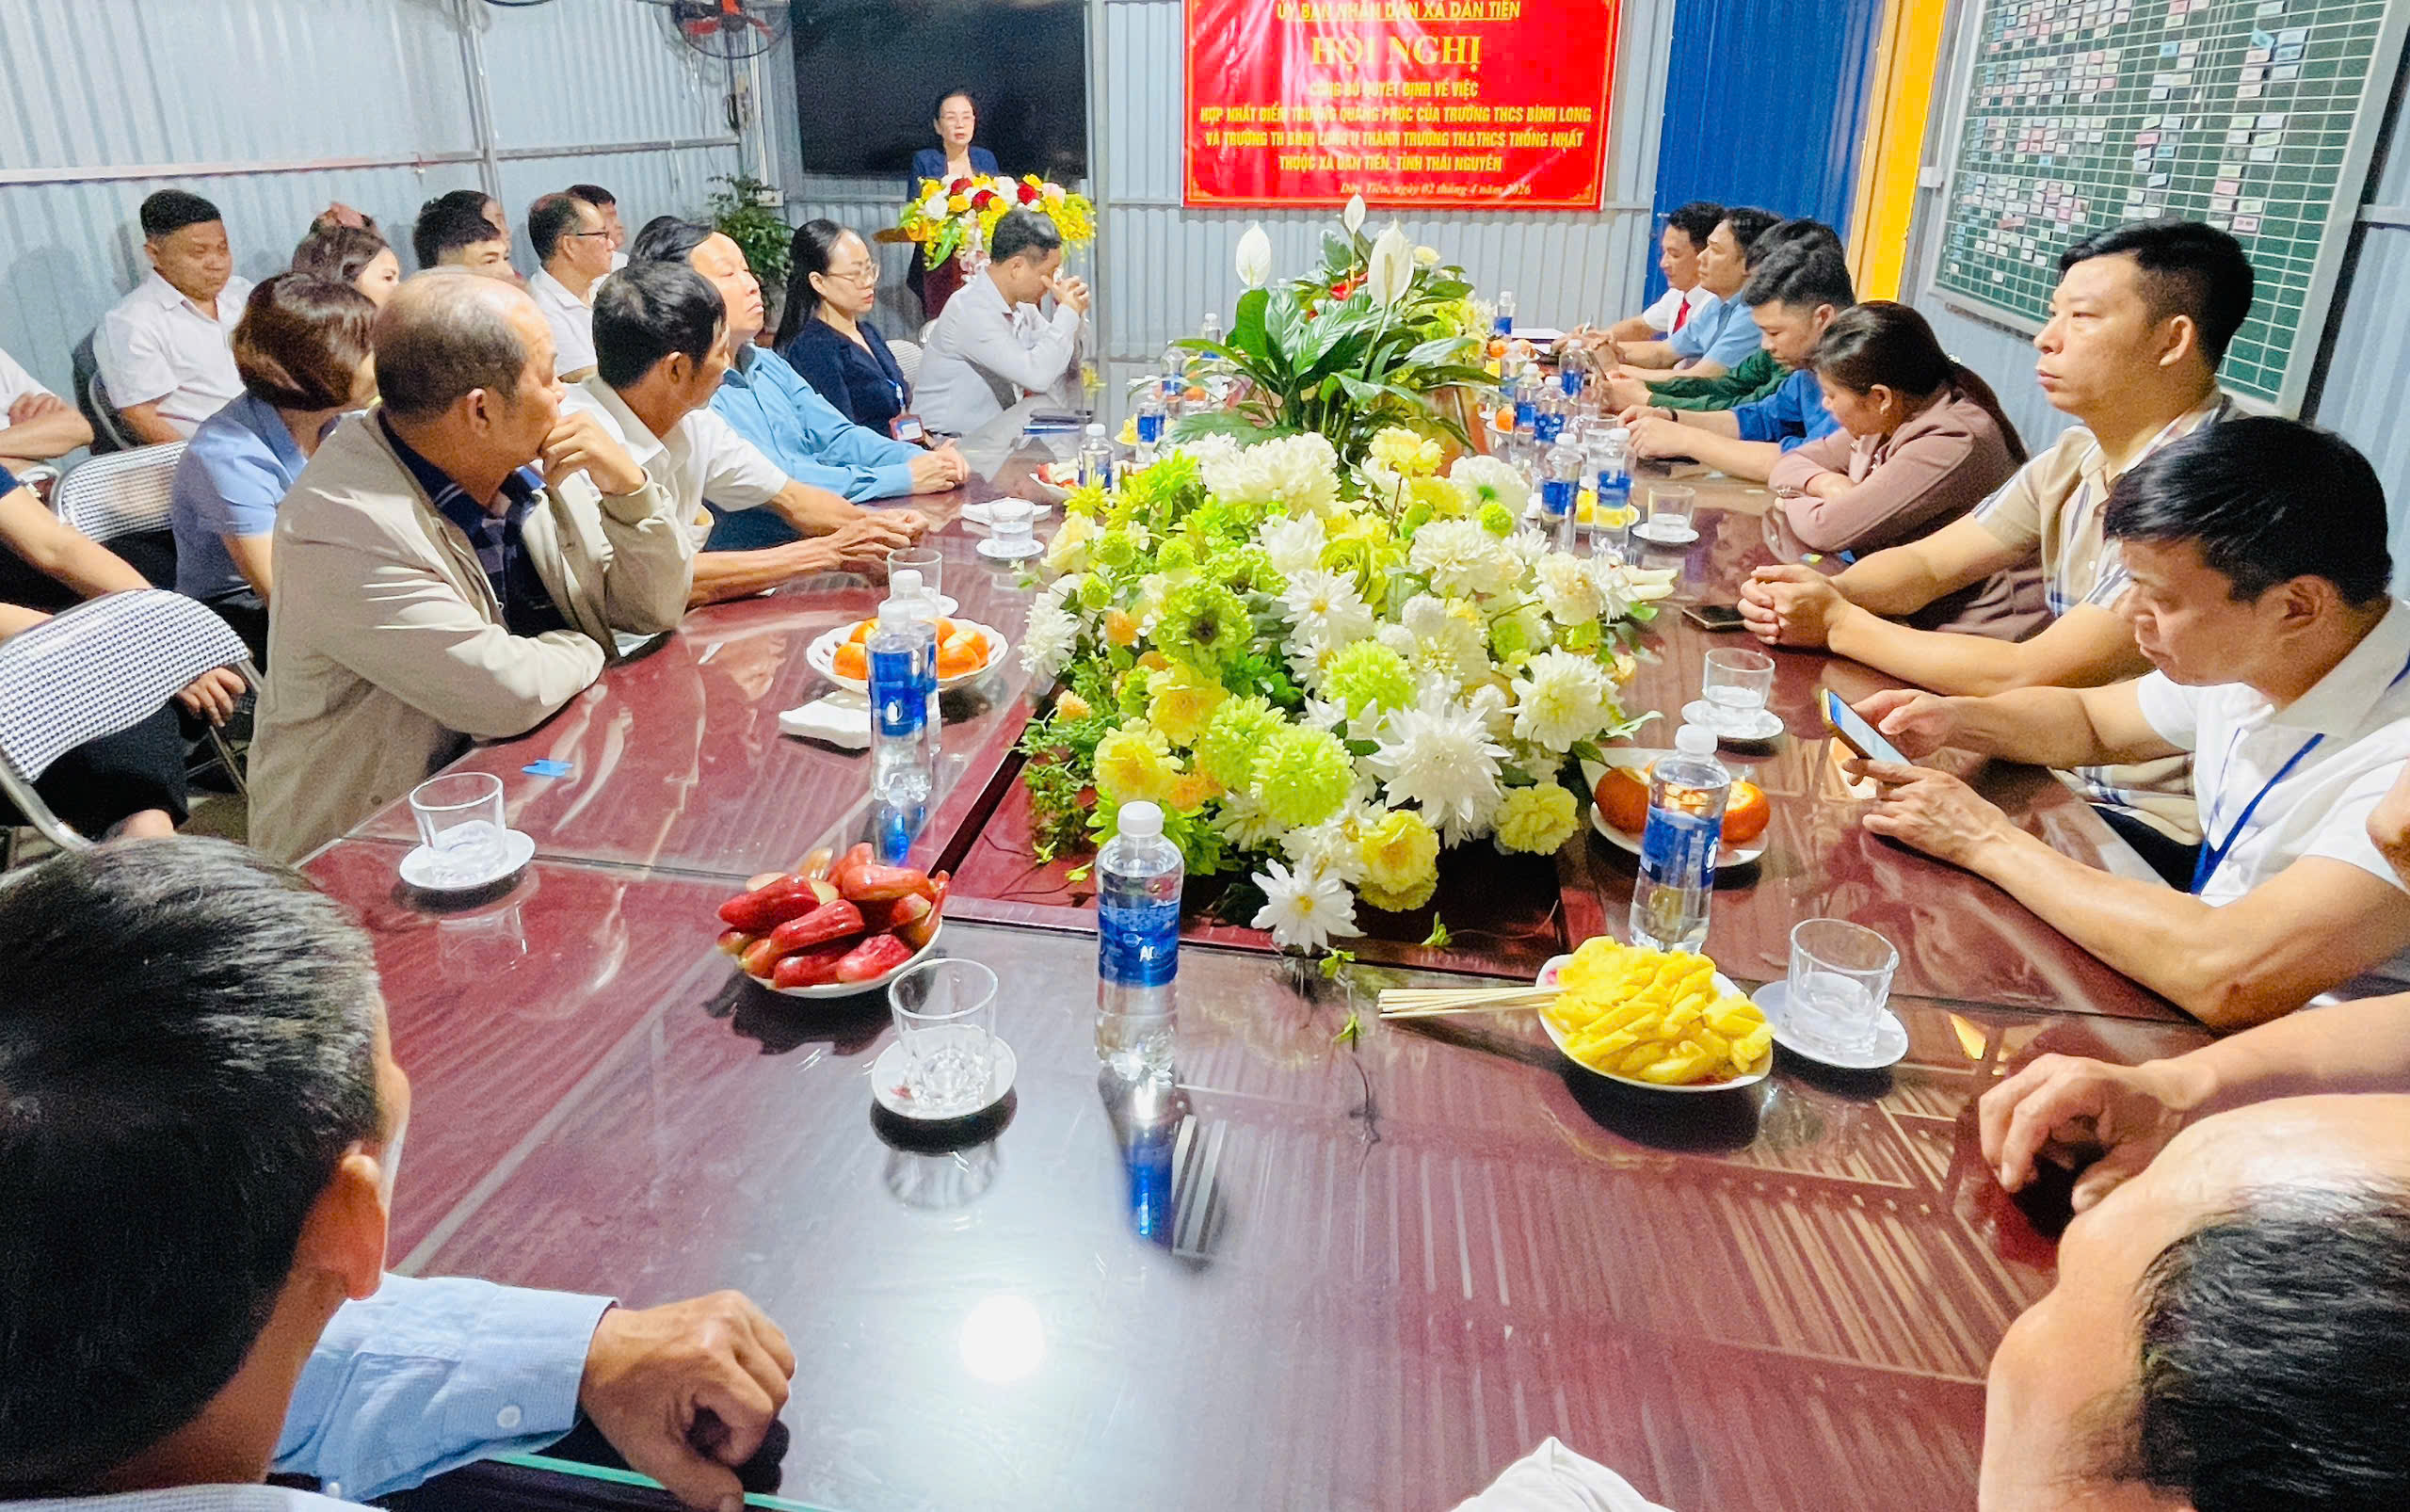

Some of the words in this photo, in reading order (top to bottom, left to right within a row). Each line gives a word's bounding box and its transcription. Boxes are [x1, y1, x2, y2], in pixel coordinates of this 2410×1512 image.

[1301, 2, 1333, 19] BAN
[1337, 1, 1382, 19] NHÂN
[1423, 0, 1445, 18] XÃ
[1451, 0, 1485, 18] DÂN
[1311, 32, 1374, 72] HỘI
[1388, 36, 1483, 72] NGHỊ
[1452, 76, 1479, 101] VIỆC
[1200, 105, 1224, 126] HỢP
[1227, 102, 1257, 122] NHẤT
[1416, 102, 1440, 122] CỦA
[1443, 103, 1491, 122] TRƯỜNG
[1493, 105, 1524, 123] THCS
[1526, 103, 1557, 123] BÌNH
[1559, 105, 1592, 123] LONG
[1206, 127, 1221, 147] VÀ
[1223, 127, 1268, 147] TRƯỜNG
[1271, 131, 1285, 147] TH
[1287, 128, 1315, 147] BÌNH
[1362, 128, 1401, 147] THÀNH
[1404, 127, 1450, 147] TRƯỜNG
[1453, 131, 1507, 148] TH&THCS
[1509, 125, 1550, 148] THỐNG
[1279, 153, 1316, 173] THUỘC
[1319, 153, 1335, 170] XÃ
[1396, 151, 1423, 171] TỈNH
[1425, 153, 1453, 171] THÁI
[1454, 153, 1503, 171] NGUYÊN
[1422, 183, 1435, 195] 02
[1470, 184, 1478, 195] 4
